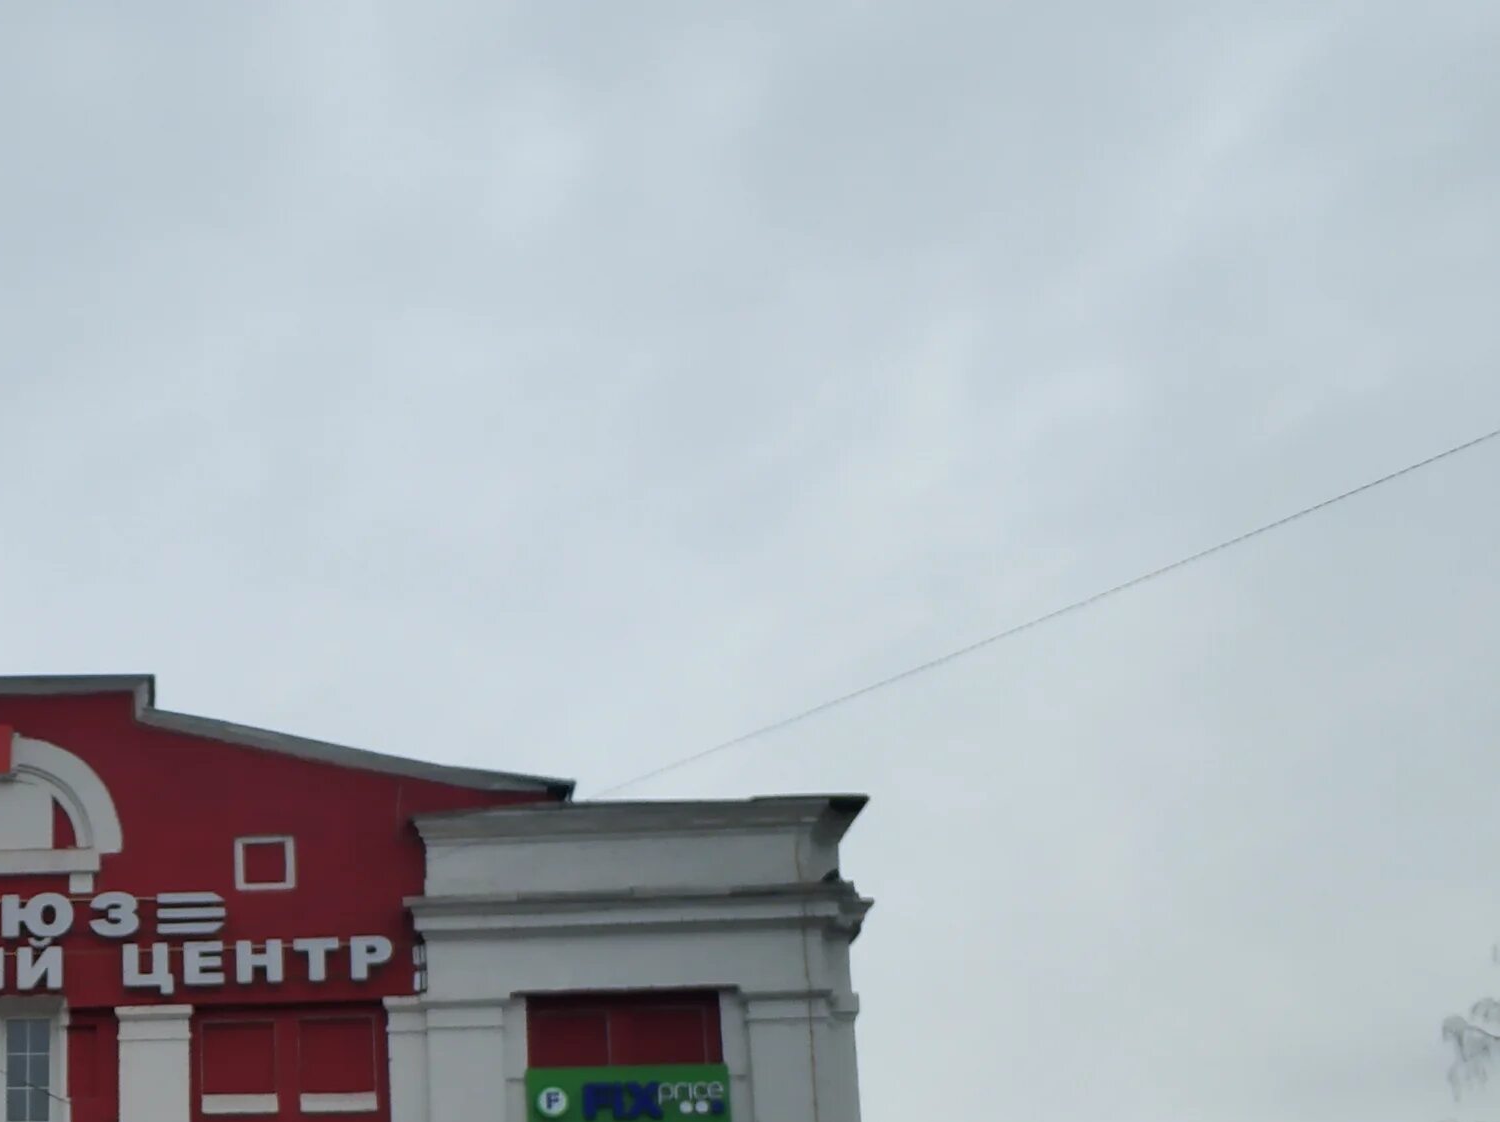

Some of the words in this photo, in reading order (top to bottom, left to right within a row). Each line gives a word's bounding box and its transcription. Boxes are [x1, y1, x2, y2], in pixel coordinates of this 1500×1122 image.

[122, 935, 395, 994] ЦЕНТР
[583, 1081, 664, 1121] FIX
[658, 1081, 724, 1104] price
